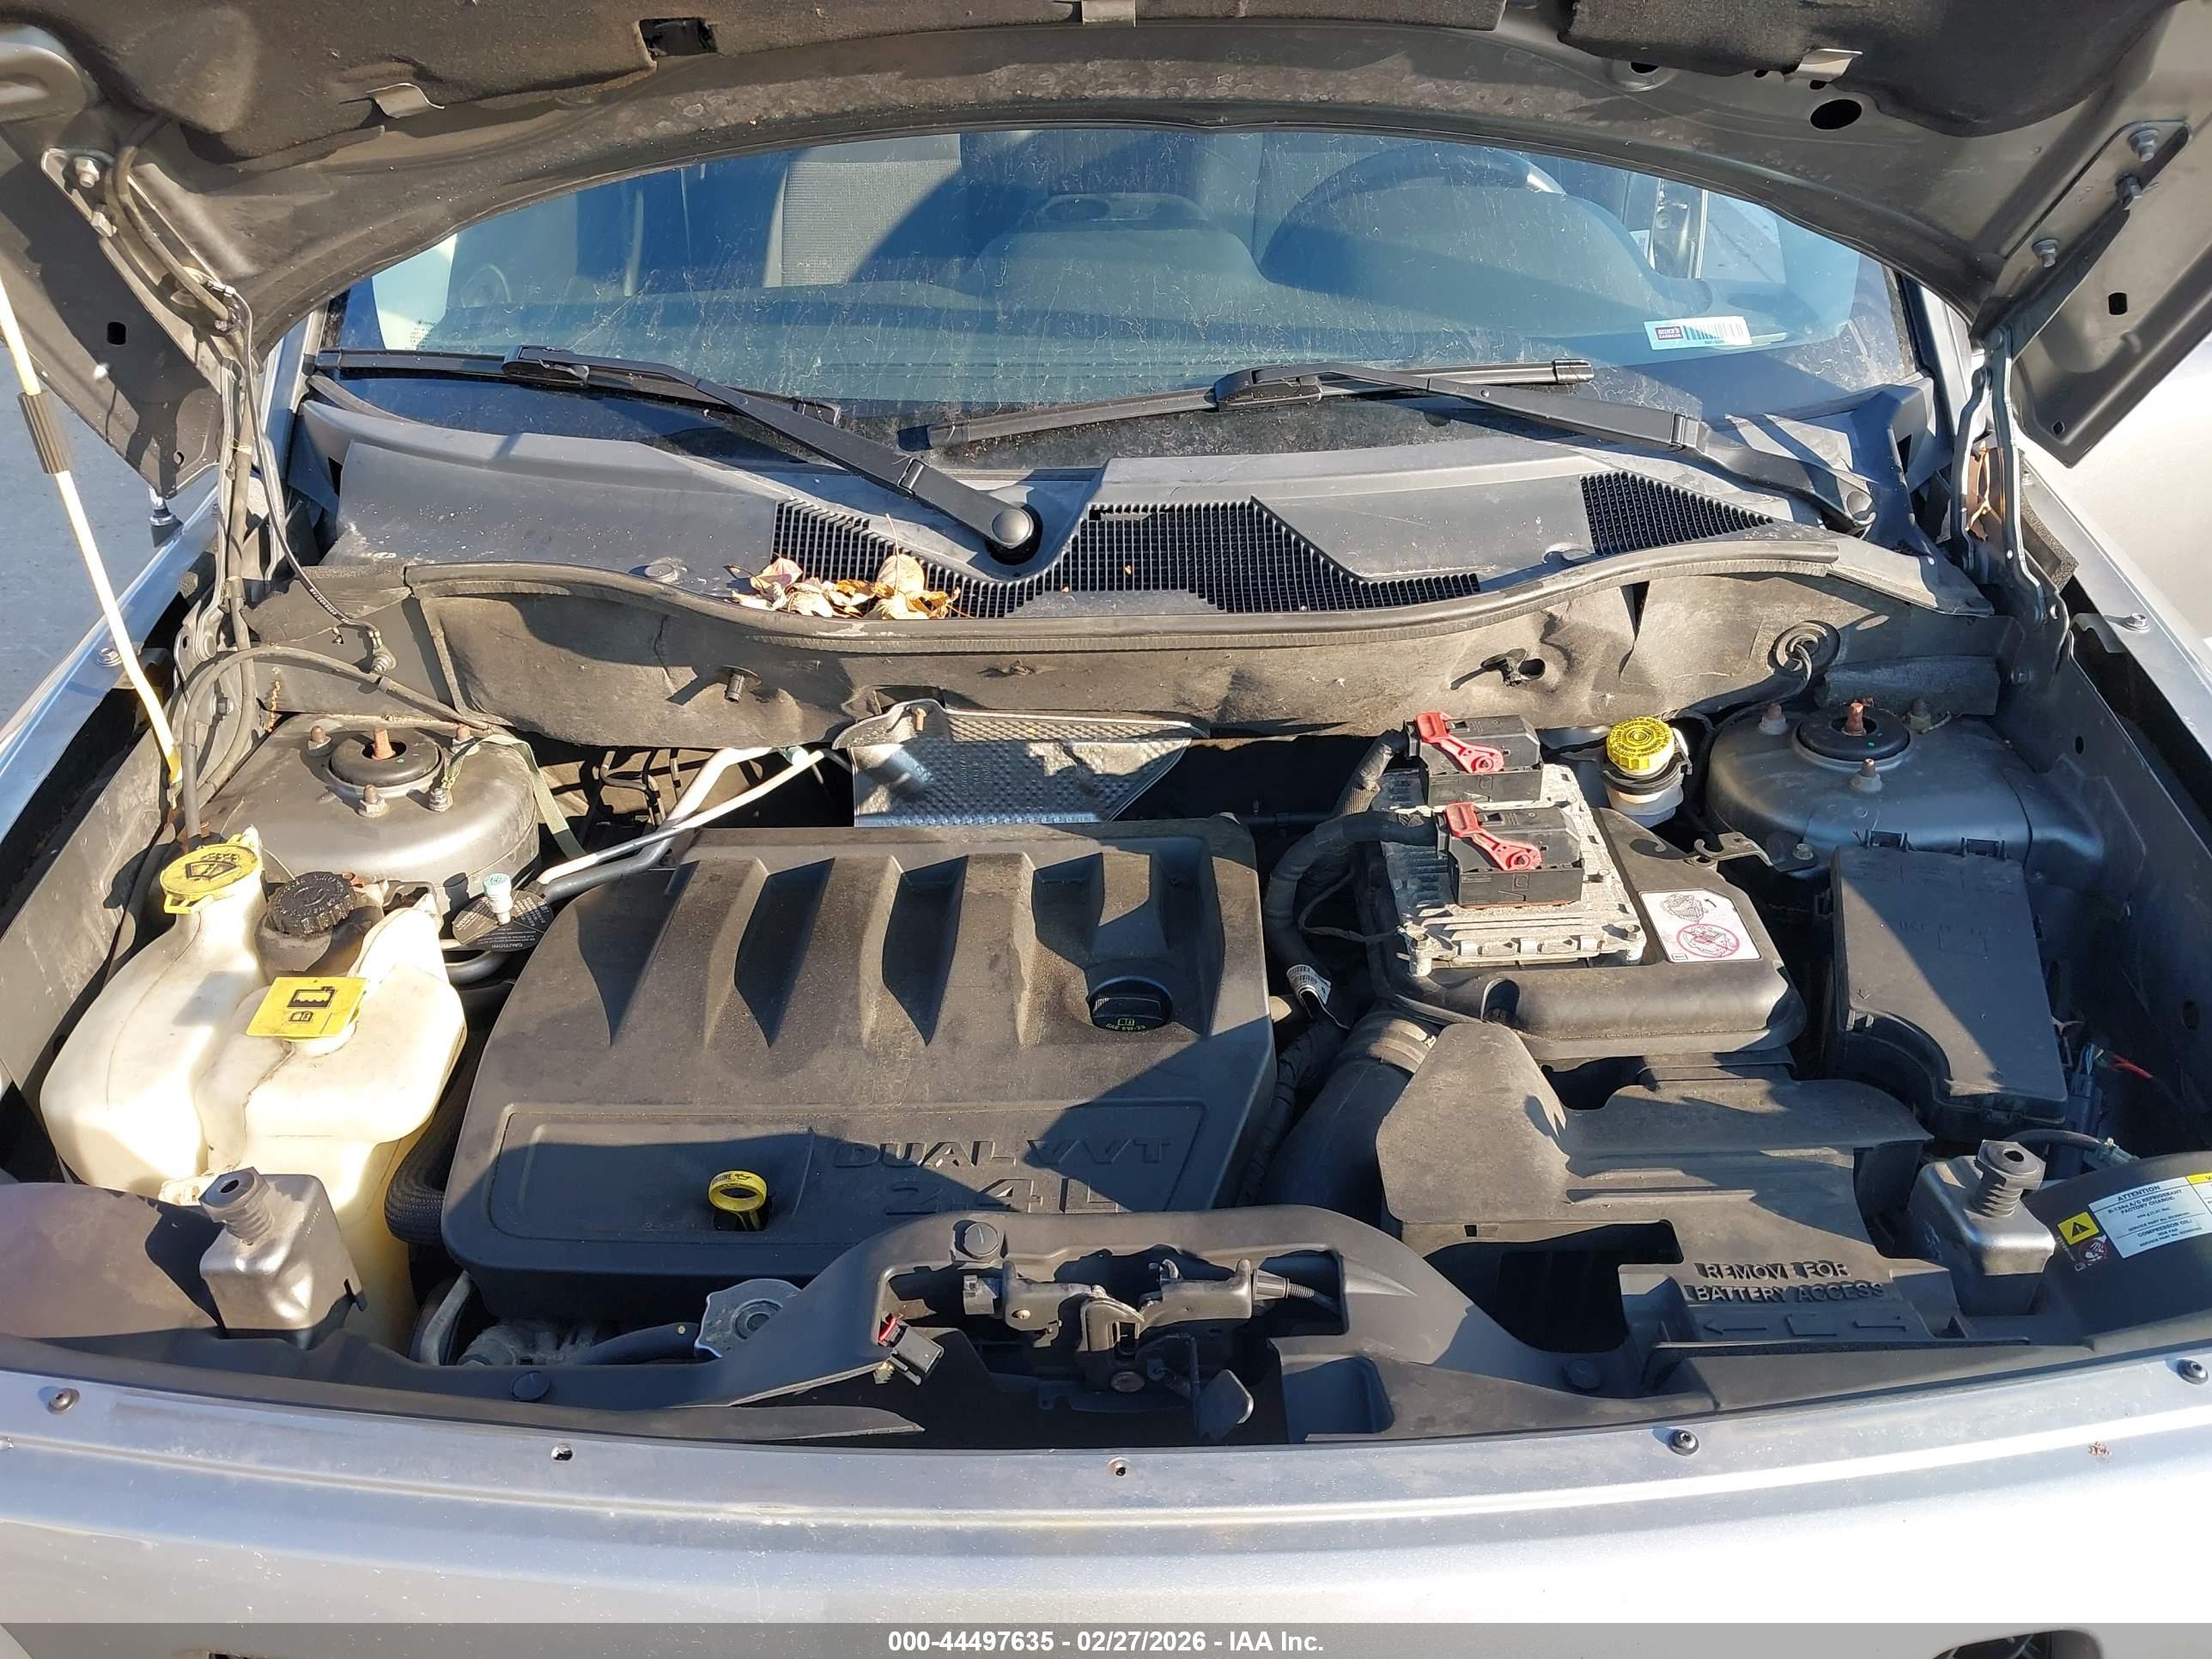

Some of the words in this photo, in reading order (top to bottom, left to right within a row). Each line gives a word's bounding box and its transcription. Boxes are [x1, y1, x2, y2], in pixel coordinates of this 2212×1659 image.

[834, 1139, 1017, 1168] DUAL
[1026, 1139, 1171, 1166] VVT
[2117, 1185, 2160, 1202] ATTENTION
[1700, 1263, 1798, 1280] REMOVE
[1802, 1261, 1851, 1278] FOR
[1694, 1285, 1787, 1303] BATTERY
[1796, 1281, 1885, 1302] ACCESS
